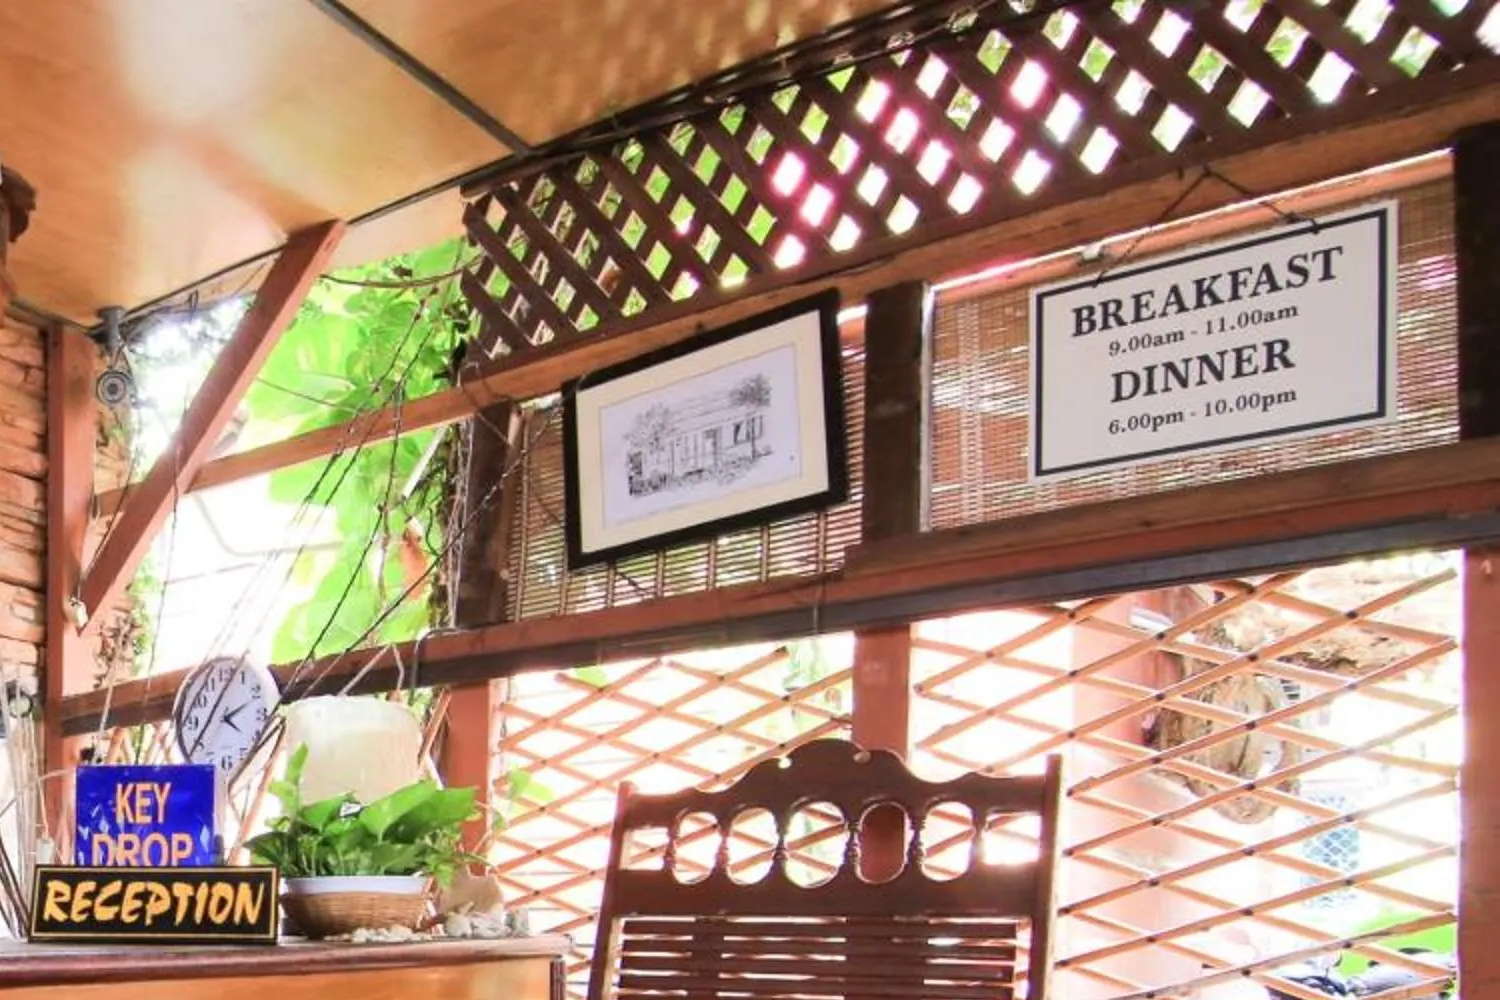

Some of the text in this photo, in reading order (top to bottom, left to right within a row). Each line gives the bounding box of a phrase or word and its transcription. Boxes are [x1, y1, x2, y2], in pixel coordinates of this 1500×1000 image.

[1072, 245, 1344, 338] BREAKFAST
[1108, 328, 1185, 357] 9.00am
[1204, 303, 1299, 336] 11.00am
[1111, 338, 1296, 403] DINNER
[1108, 409, 1185, 437] 6.00pm
[1204, 387, 1298, 420] 10.00pm
[114, 782, 172, 825] KEY
[91, 832, 194, 867] DROP
[43, 879, 266, 927] RECEPTION
